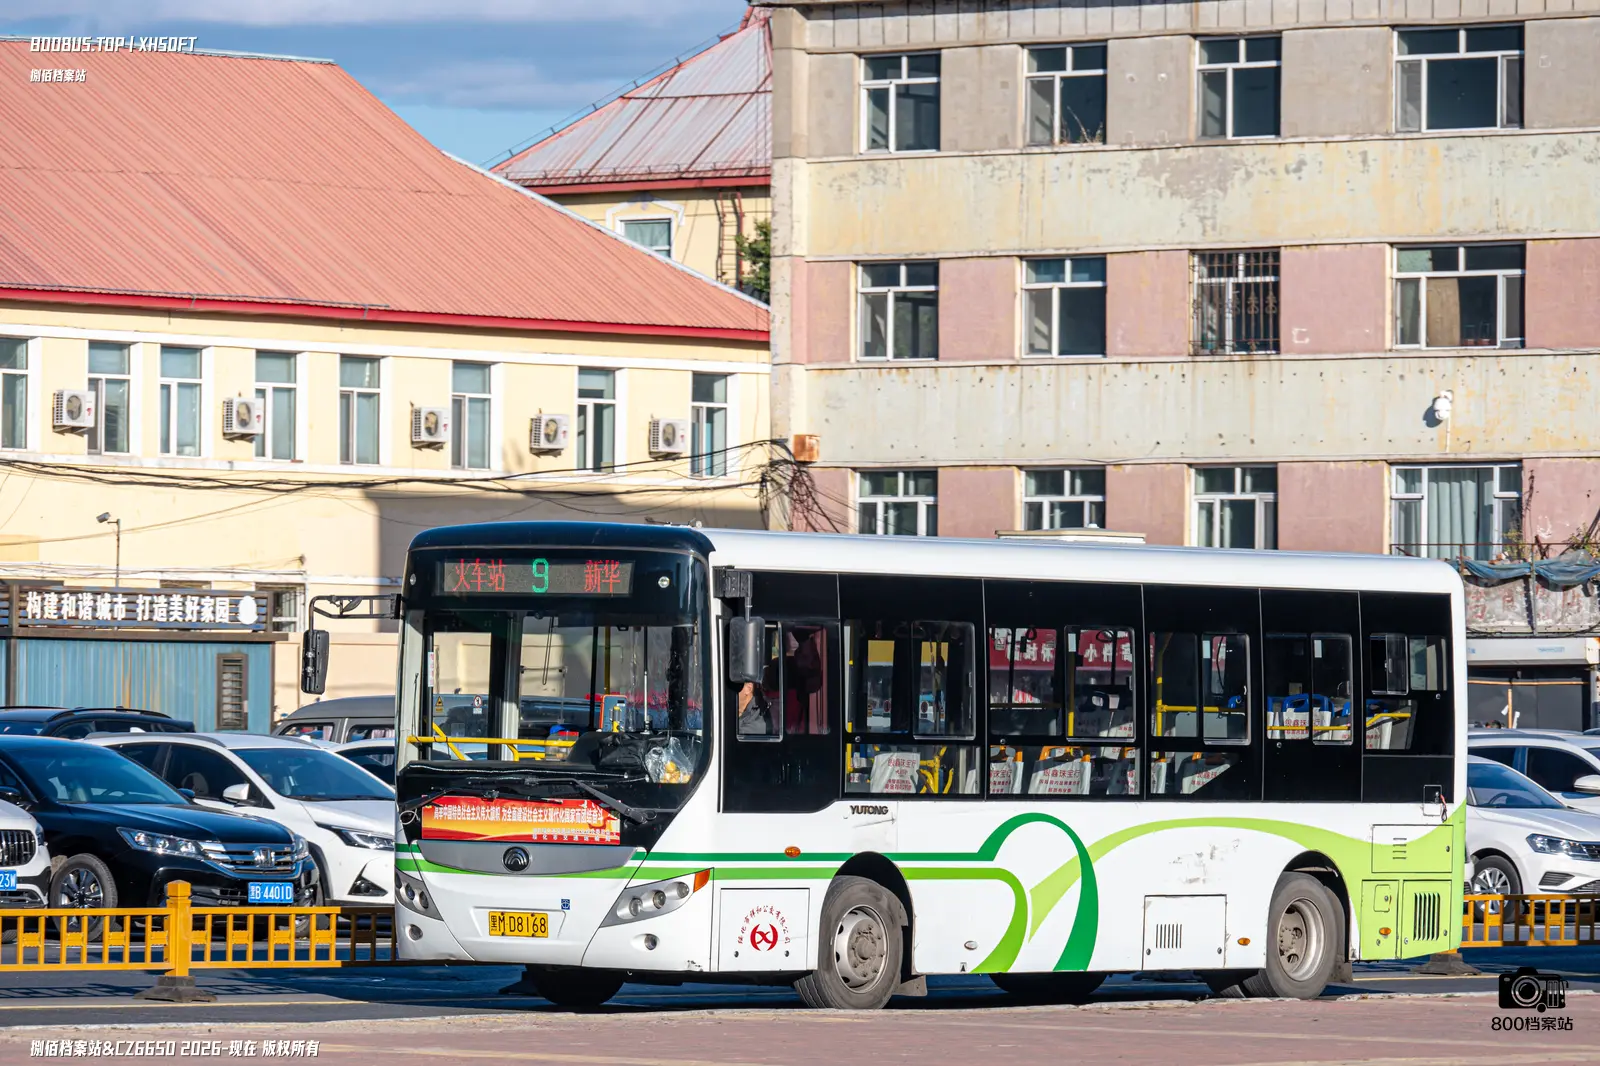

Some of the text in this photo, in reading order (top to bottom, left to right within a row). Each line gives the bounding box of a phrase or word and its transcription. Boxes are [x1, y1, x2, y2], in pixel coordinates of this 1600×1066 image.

[452, 558, 621, 593] 火车站 9 新华
[26, 591, 230, 623] 构建和谐城市 打造美好家园
[849, 804, 889, 815] YUTONG
